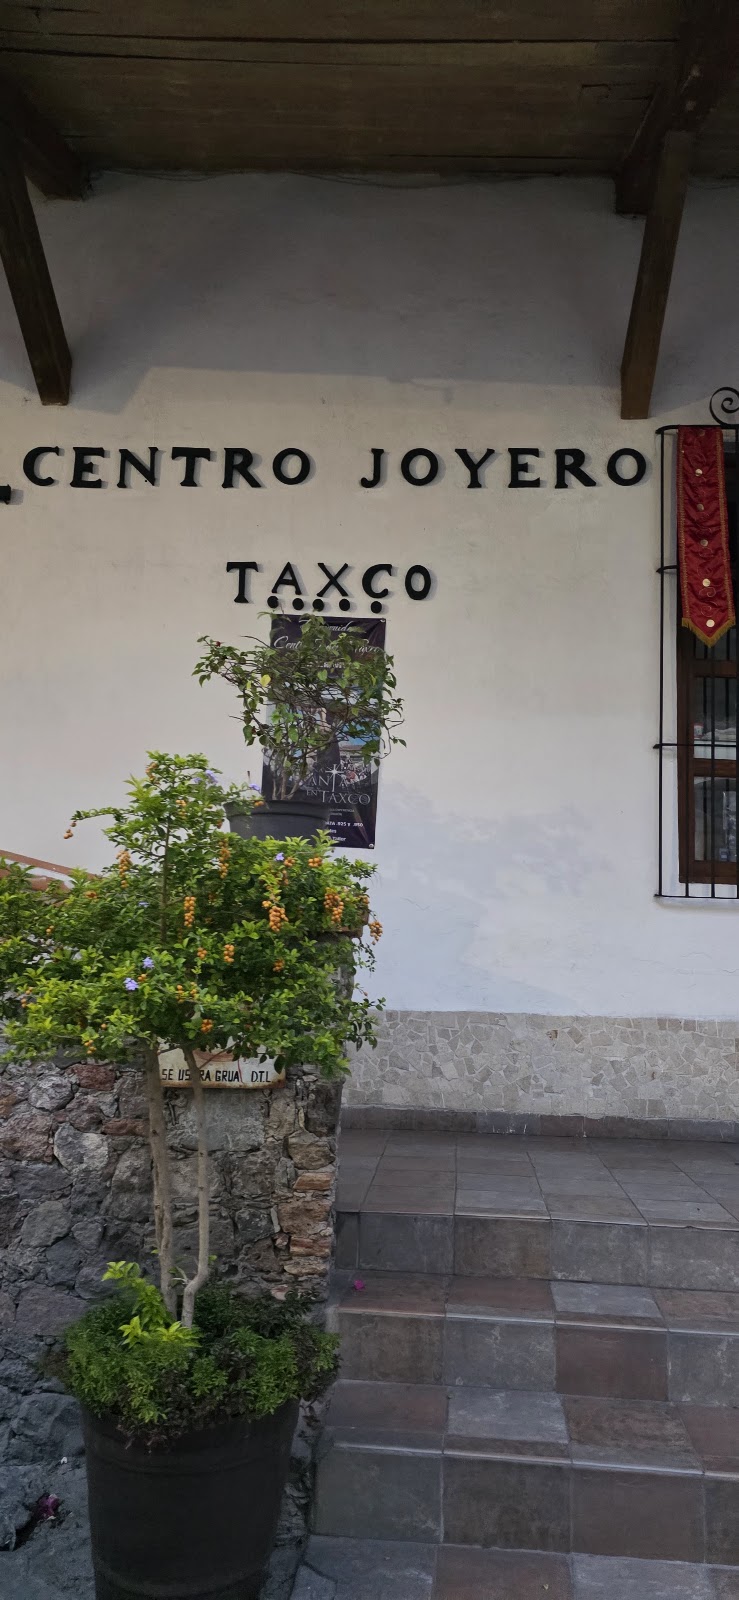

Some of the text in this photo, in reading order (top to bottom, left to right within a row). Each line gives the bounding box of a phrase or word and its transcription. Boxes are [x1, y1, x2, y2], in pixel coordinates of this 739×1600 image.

[22, 446, 648, 489] CENTRO JOYERO
[226, 561, 433, 604] TAXCO
[320, 790, 371, 805] TAXCO
[161, 1068, 173, 1081] SE
[178, 1068, 211, 1081] USRA
[215, 1070, 240, 1083] GRUA
